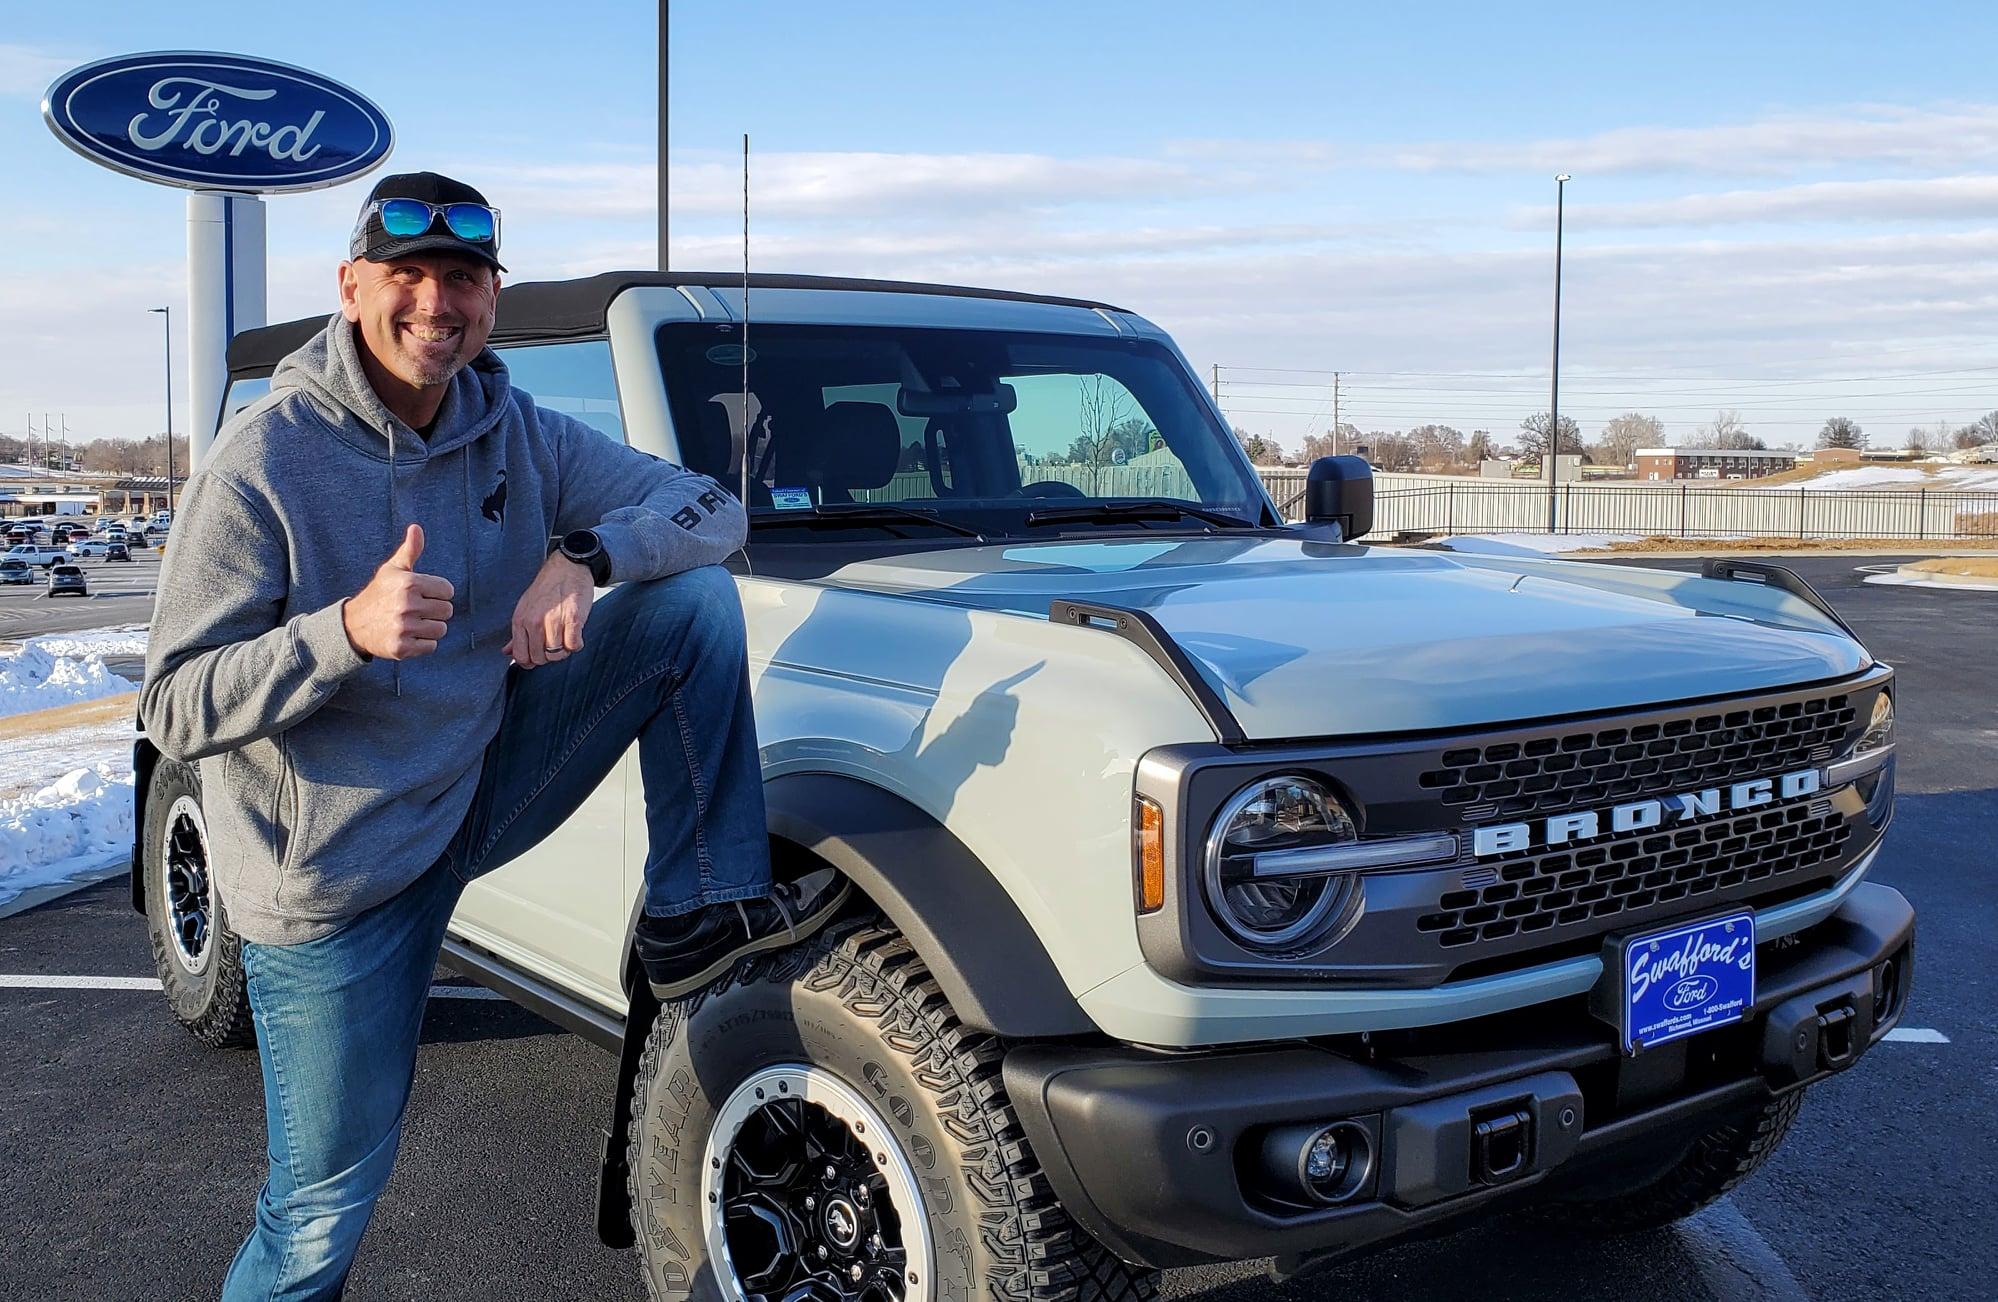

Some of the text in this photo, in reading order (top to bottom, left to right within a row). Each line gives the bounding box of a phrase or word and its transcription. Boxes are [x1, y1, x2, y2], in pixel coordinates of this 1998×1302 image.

[128, 77, 326, 162] Ford
[1474, 768, 1820, 857] BRONCO
[1631, 932, 1752, 1004] Swafford's
[1673, 979, 1708, 1006] Ford
